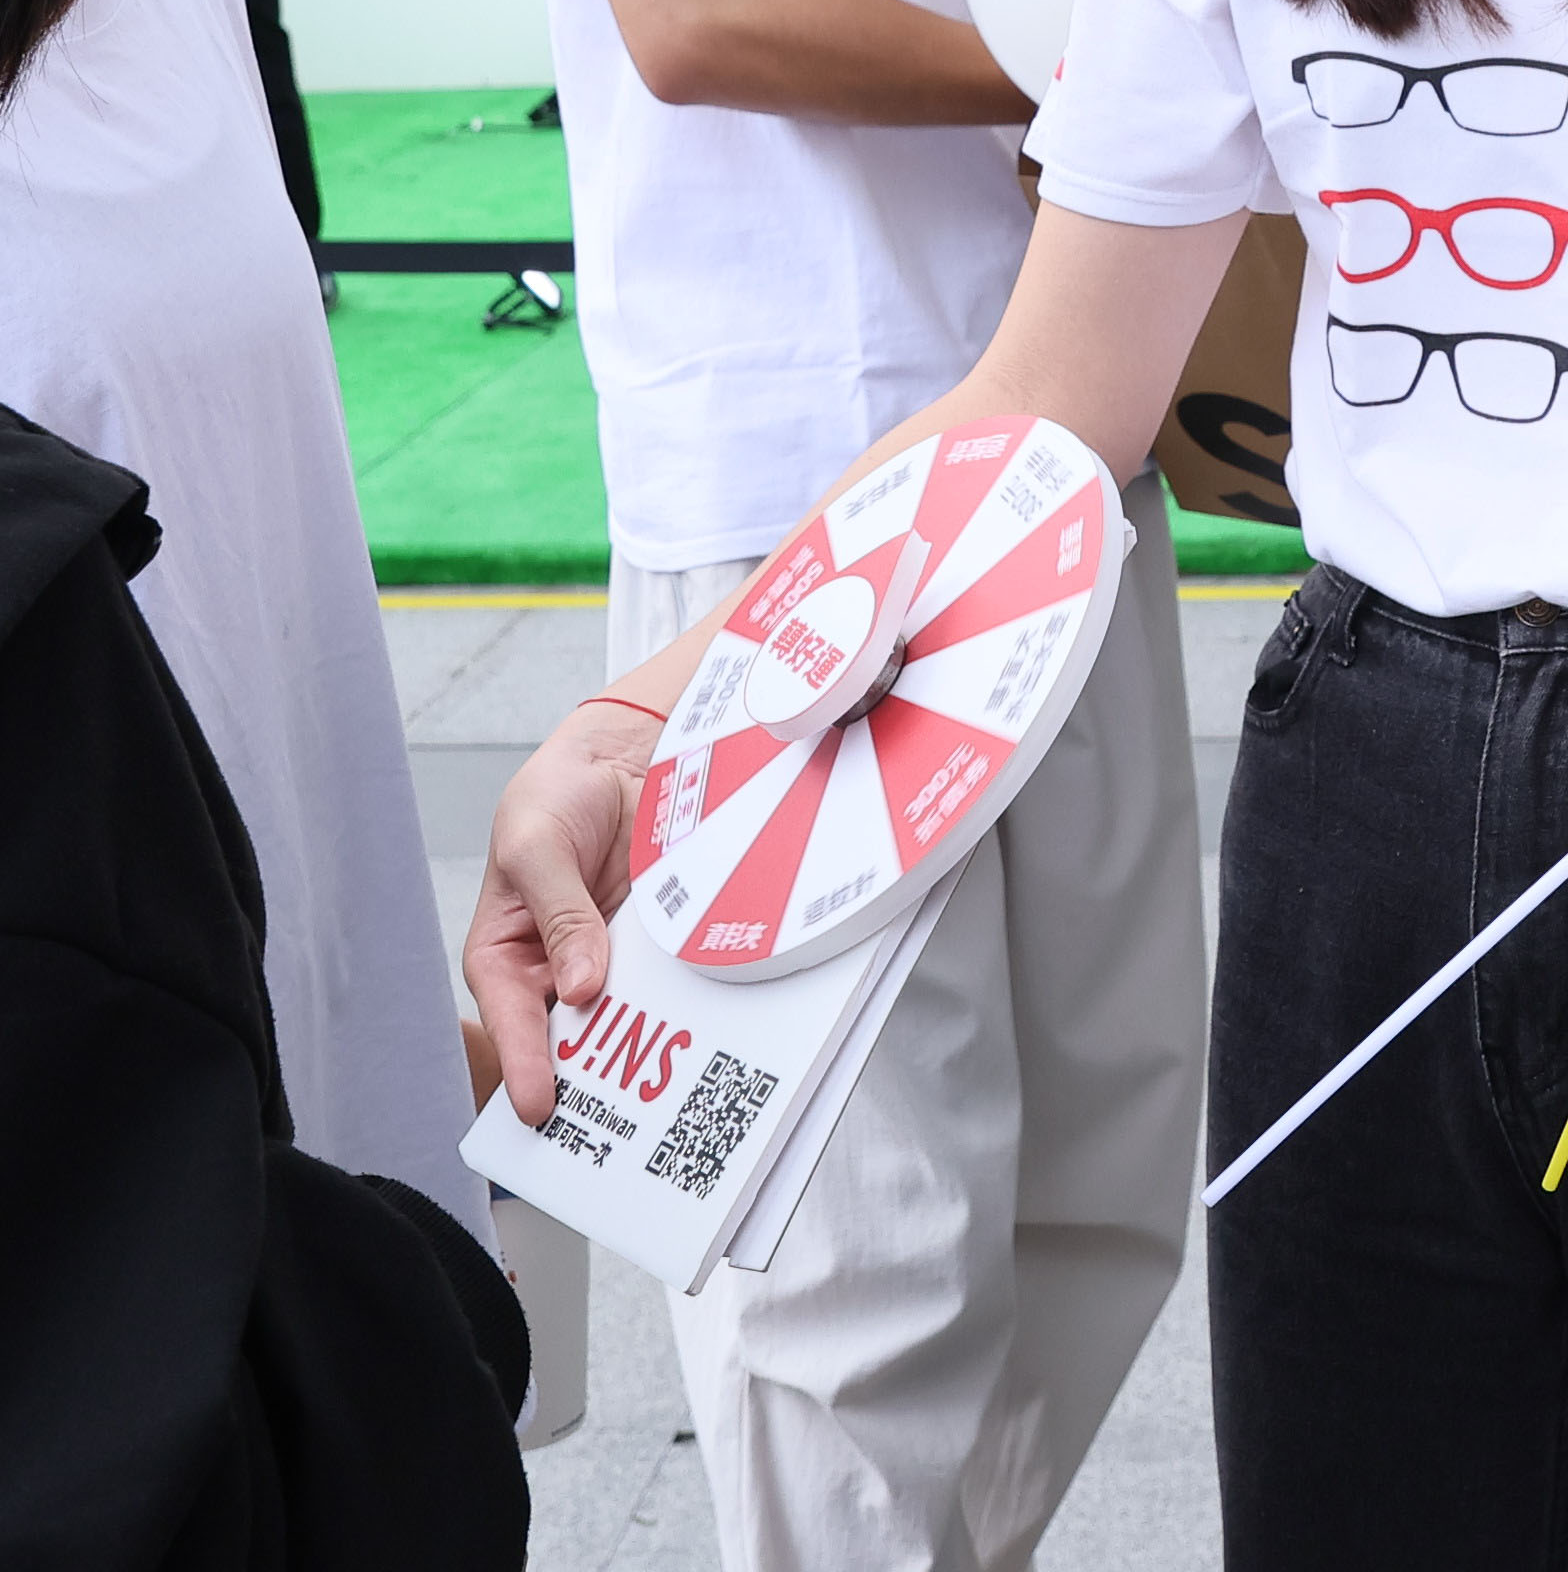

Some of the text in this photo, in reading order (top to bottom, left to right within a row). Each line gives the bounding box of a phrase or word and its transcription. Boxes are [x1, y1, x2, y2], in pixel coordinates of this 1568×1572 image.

[769, 616, 846, 690] 轉好運
[697, 920, 769, 952] 資料夾
